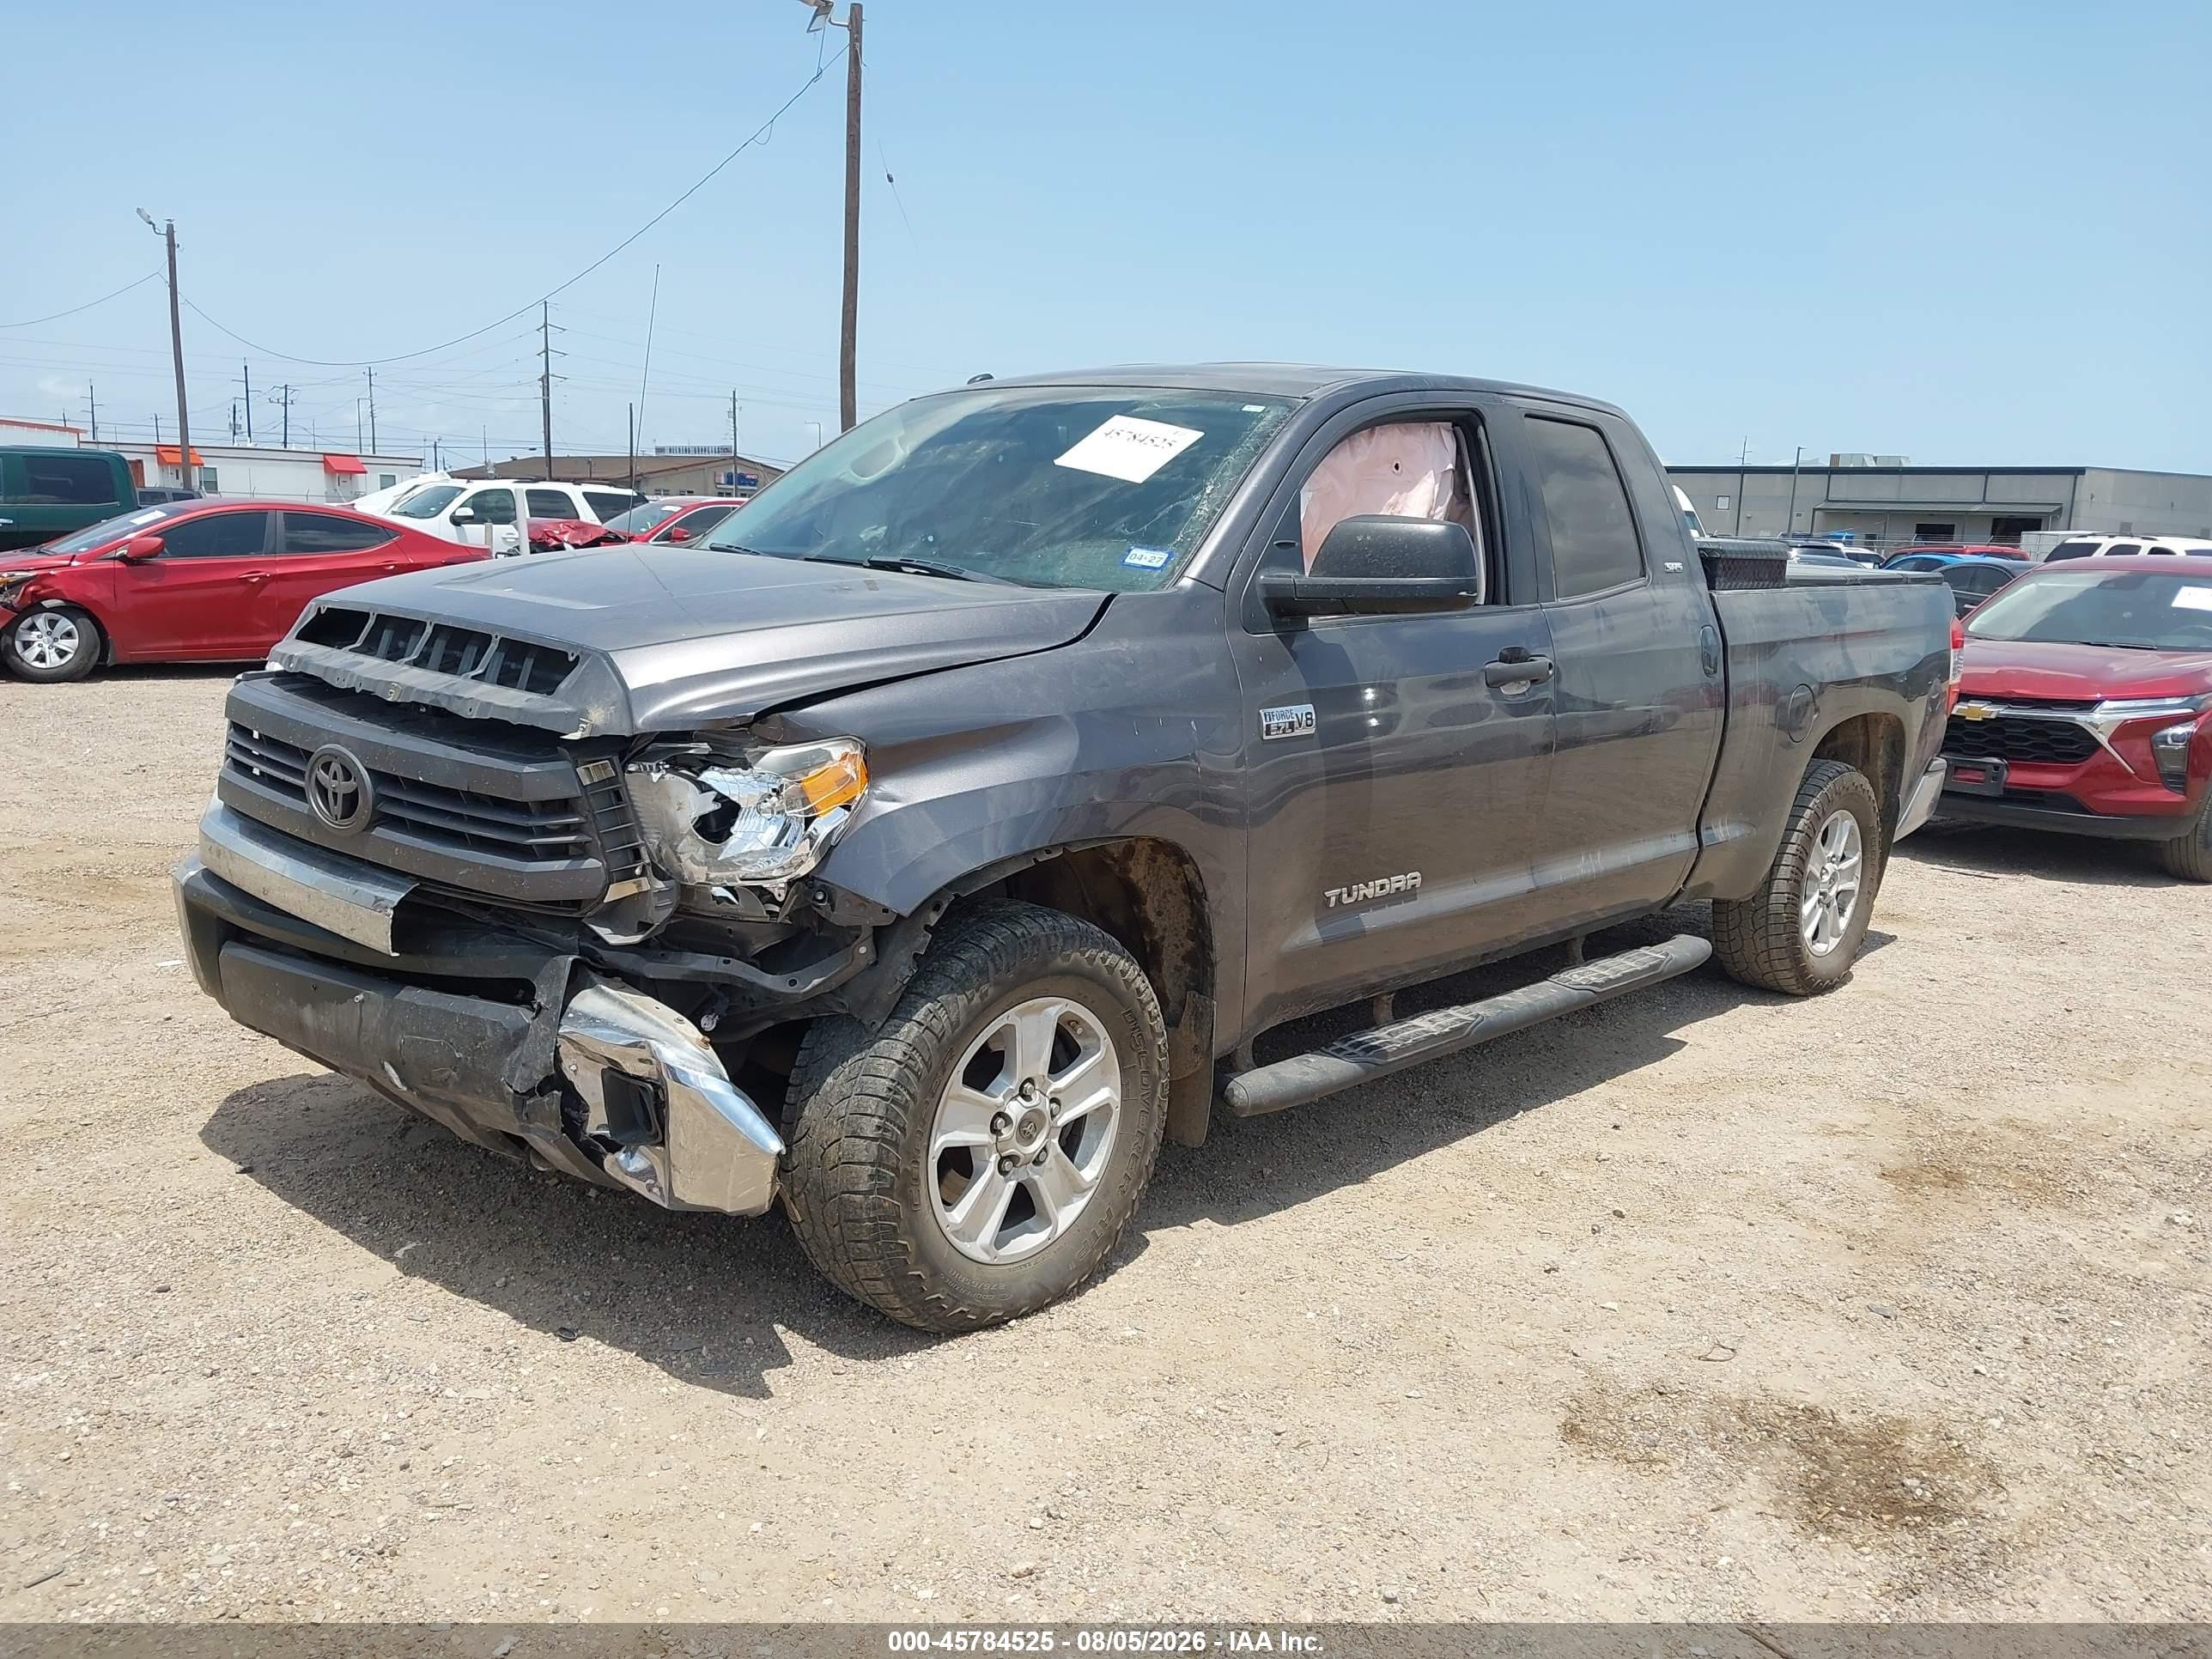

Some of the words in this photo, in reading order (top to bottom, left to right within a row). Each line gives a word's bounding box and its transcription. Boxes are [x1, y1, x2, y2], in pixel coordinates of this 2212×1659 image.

[1295, 711, 1314, 729] V8
[1324, 871, 1422, 908] TUNDRA
[1120, 1008, 1151, 1196] DISCOVERER
